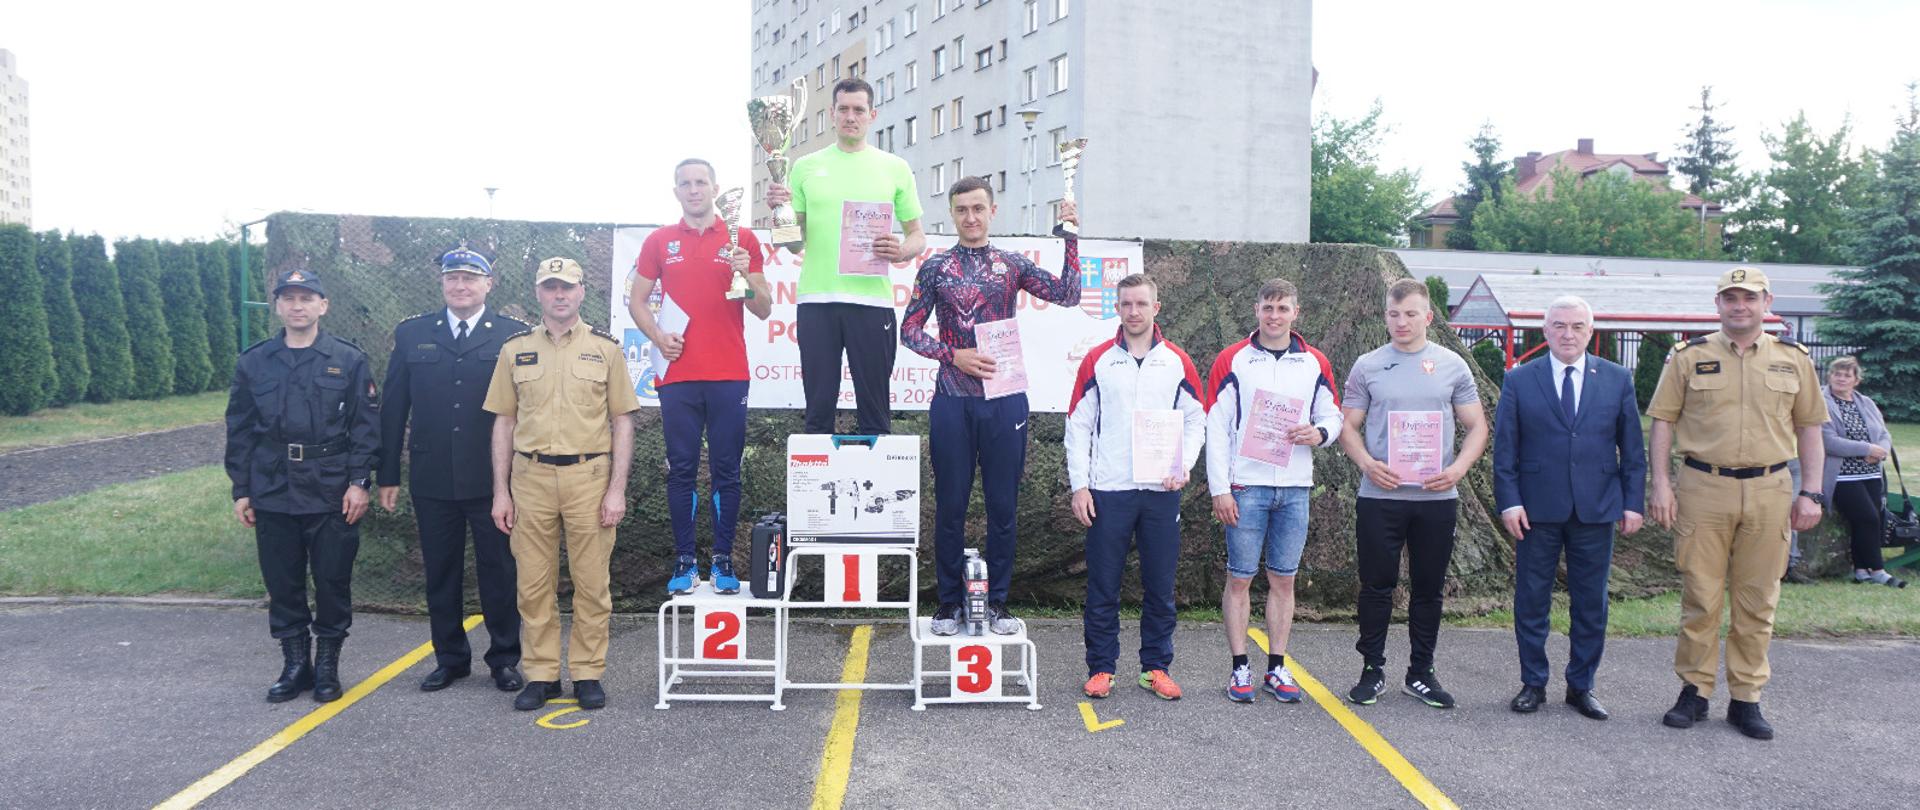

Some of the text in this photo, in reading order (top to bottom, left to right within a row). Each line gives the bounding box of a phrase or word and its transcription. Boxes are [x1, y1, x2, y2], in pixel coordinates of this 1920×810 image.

[903, 389, 934, 403] 202
[841, 554, 860, 601] 1
[703, 611, 740, 659] 2
[957, 645, 992, 693] 3
